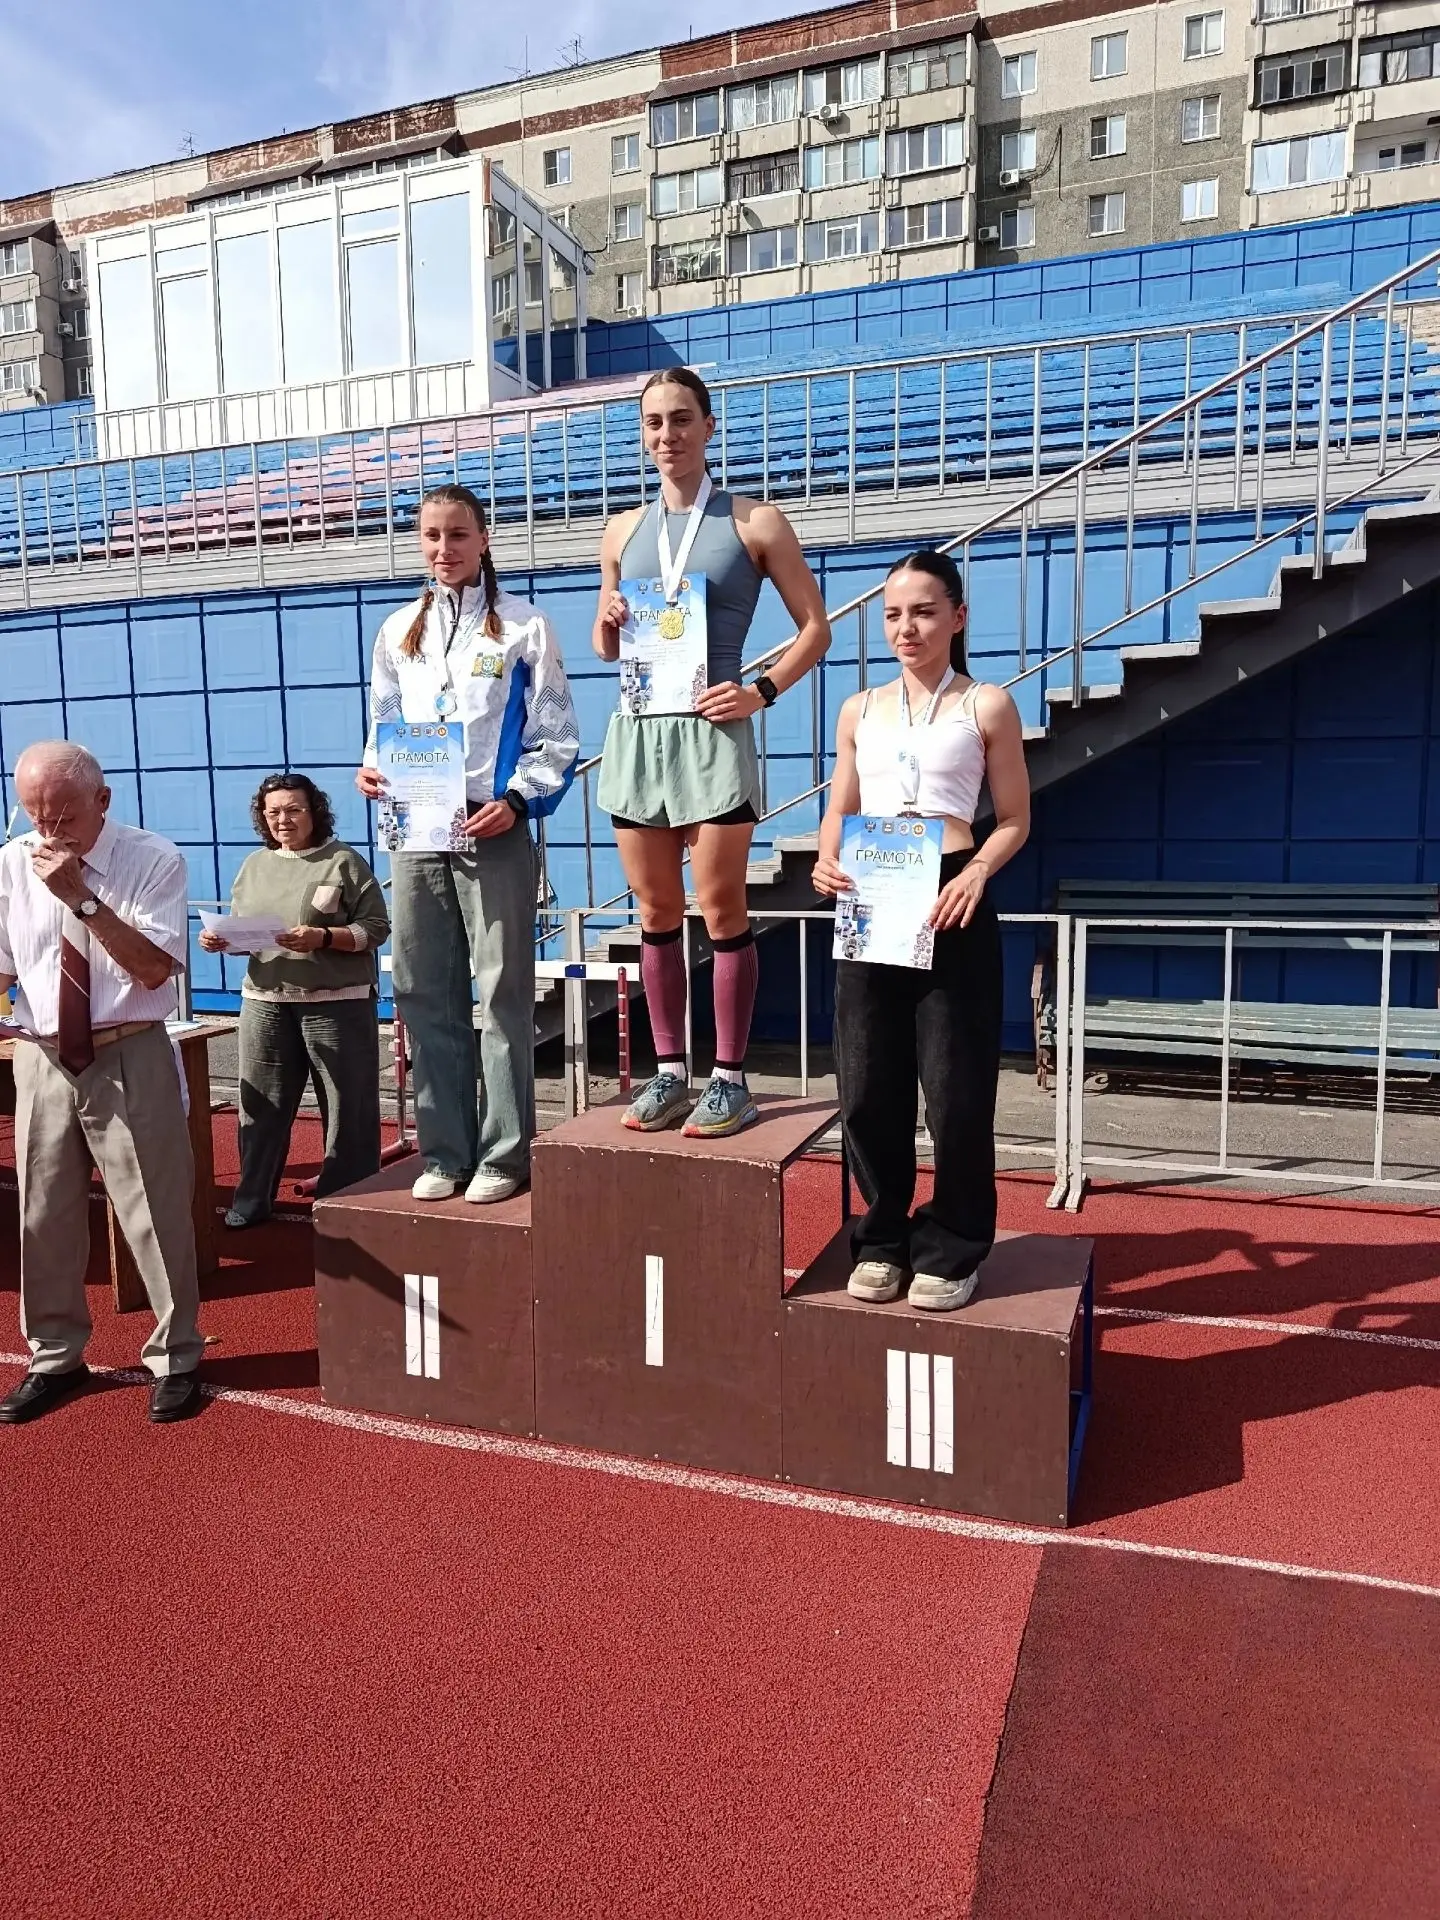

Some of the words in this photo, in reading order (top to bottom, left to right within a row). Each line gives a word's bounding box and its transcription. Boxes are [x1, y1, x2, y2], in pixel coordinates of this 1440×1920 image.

[633, 607, 692, 622] ГРАМТА
[391, 752, 450, 763] ГРАМОТА
[856, 849, 924, 866] ГРАМОТА
[886, 1348, 954, 1475] III
